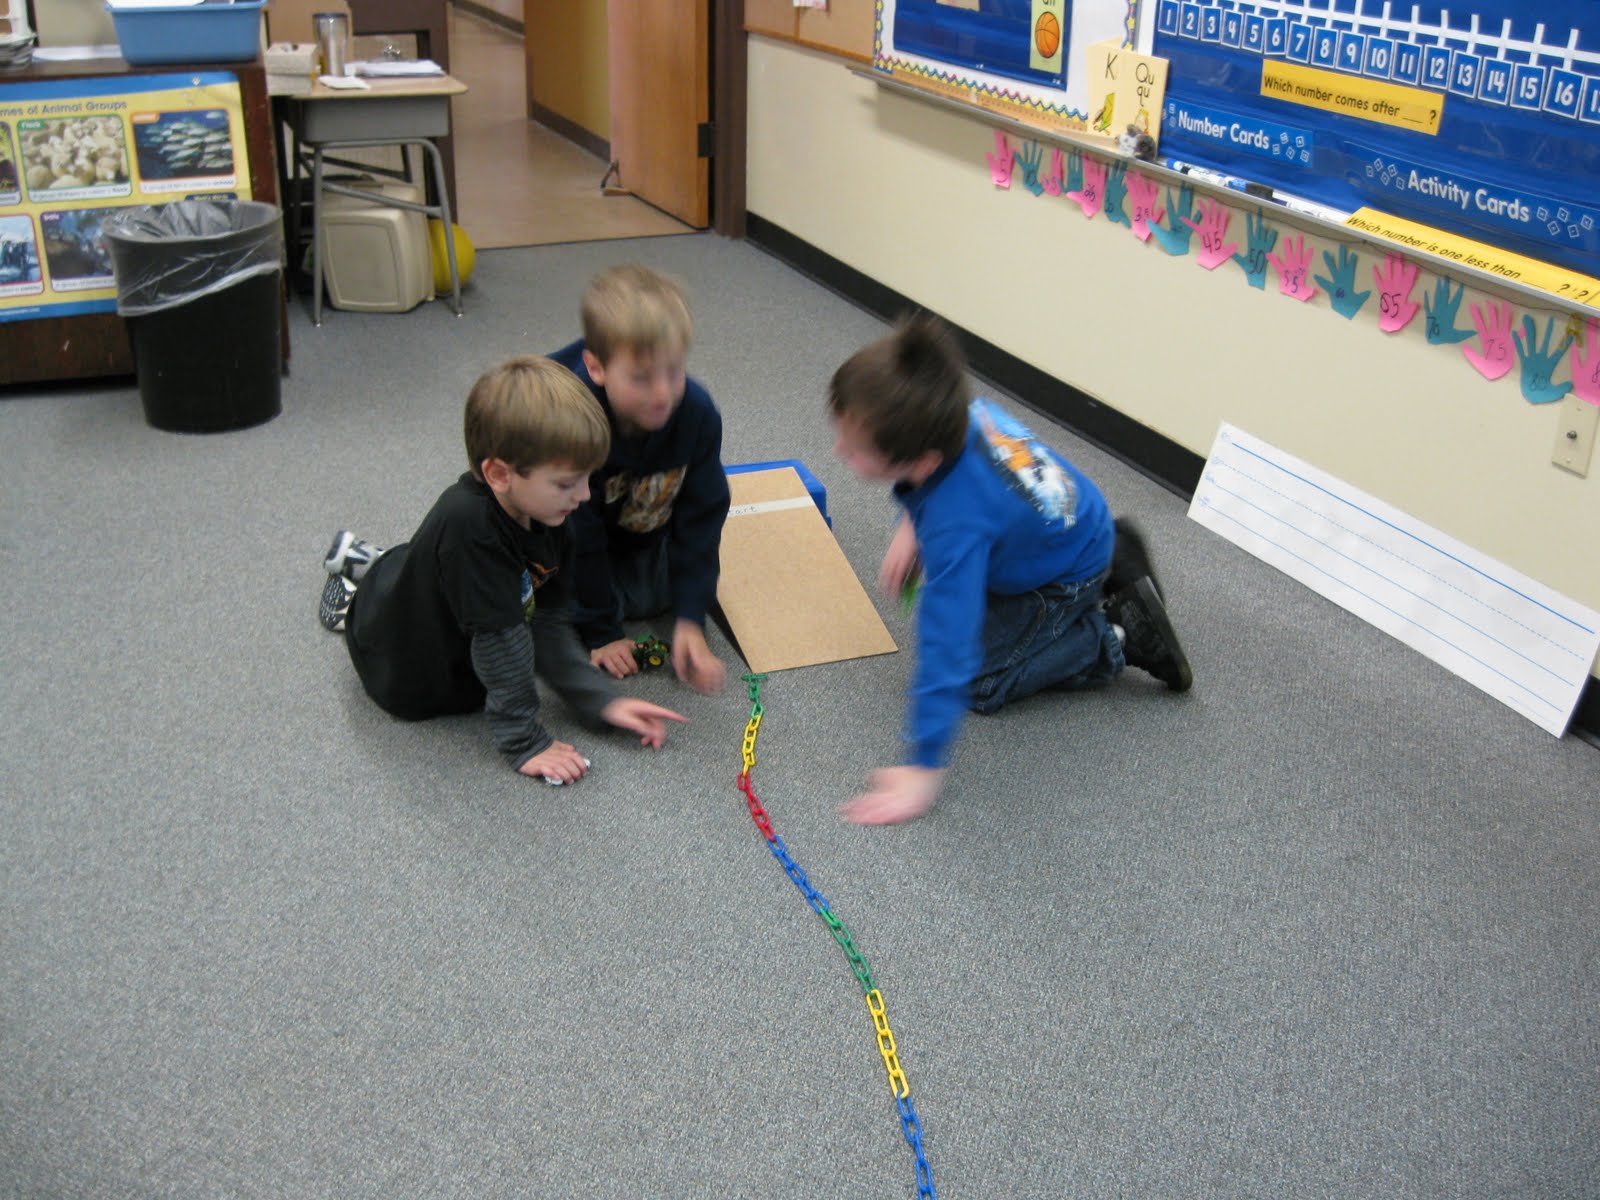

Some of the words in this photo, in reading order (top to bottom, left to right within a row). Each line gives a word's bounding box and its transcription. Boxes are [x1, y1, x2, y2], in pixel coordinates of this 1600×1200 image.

[1105, 53, 1118, 80] K
[1135, 62, 1155, 85] Qu
[1166, 9, 1173, 26] 1
[1186, 12, 1195, 30] 2
[1207, 16, 1216, 34] 3
[1228, 20, 1236, 39] 4
[1249, 23, 1259, 43] 5
[1271, 27, 1281, 47] 6
[1295, 33, 1305, 52] 7
[1320, 38, 1329, 58] 8
[1346, 42, 1356, 64] 9
[1371, 47, 1387, 69] 10
[1401, 52, 1415, 75] 11
[1429, 57, 1446, 80] 12
[1457, 63, 1473, 87] 13
[1487, 69, 1505, 94] 14
[1519, 76, 1538, 100] 15
[1554, 81, 1574, 107] 16
[1590, 89, 1600, 113] 1
[27, 104, 38, 115] of
[42, 103, 82, 114] Animal
[86, 101, 127, 112] Groups
[1136, 86, 1151, 107] qu
[1263, 75, 1293, 94] Which
[1295, 85, 1333, 102] number
[1335, 94, 1369, 111] comes
[1372, 102, 1400, 118] after
[1178, 110, 1227, 138] Number
[1230, 123, 1270, 150] Cards
[1407, 169, 1470, 209] Activity
[1474, 188, 1531, 223] Cards
[1202, 230, 1222, 254] 45
[1347, 216, 1381, 234] Which
[1380, 229, 1427, 248] number
[1426, 242, 1439, 253] is
[1439, 248, 1463, 261] one
[1464, 255, 1489, 270] less
[1490, 264, 1521, 280] than
[1248, 248, 1266, 275] 50
[1485, 339, 1507, 361] 75
